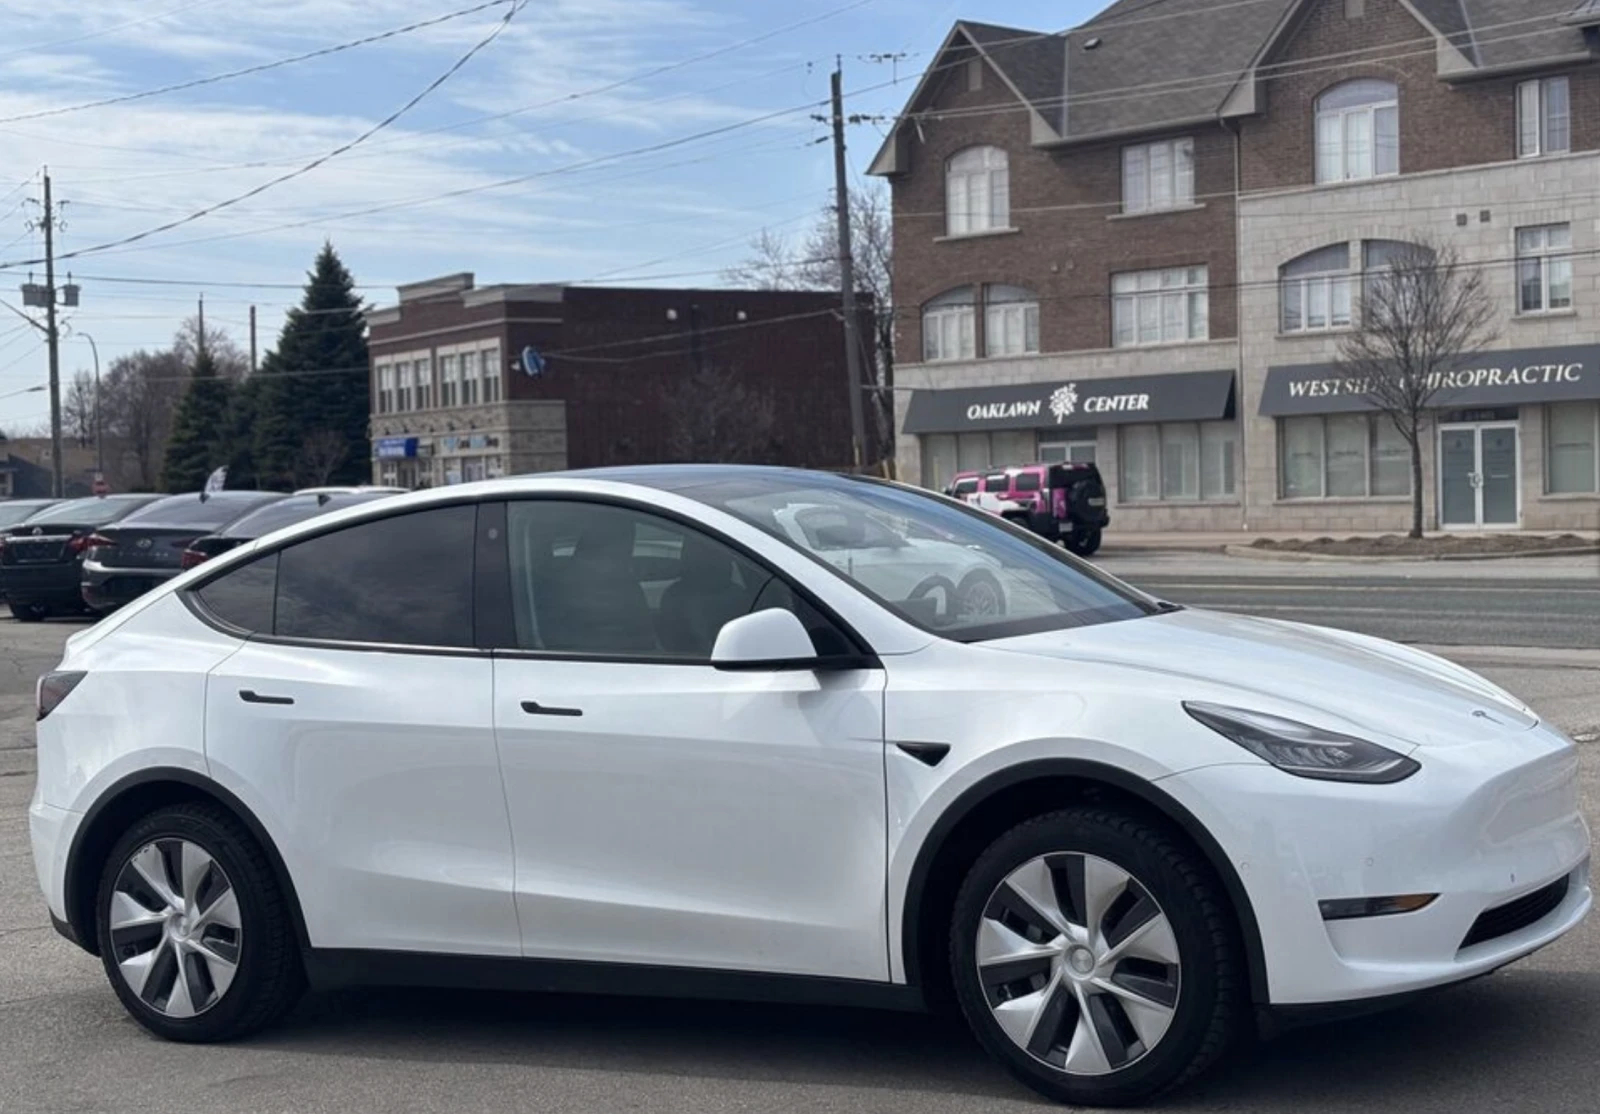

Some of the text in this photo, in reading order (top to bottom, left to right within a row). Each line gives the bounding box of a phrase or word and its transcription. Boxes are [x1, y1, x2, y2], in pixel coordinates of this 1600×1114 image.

[1289, 376, 1388, 397] WESTSI
[967, 394, 1150, 420] OAKLAWN CENTER
